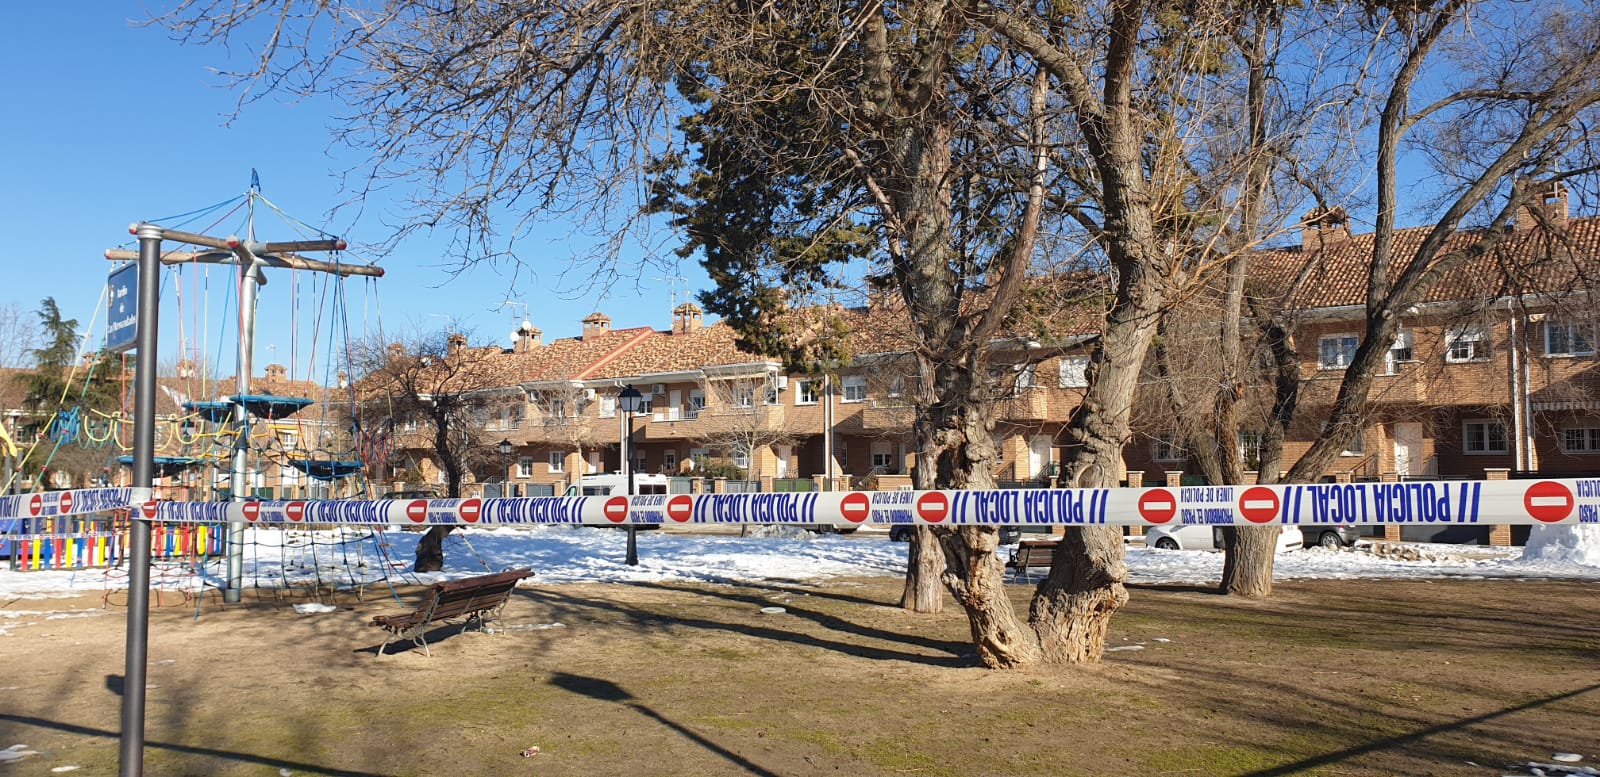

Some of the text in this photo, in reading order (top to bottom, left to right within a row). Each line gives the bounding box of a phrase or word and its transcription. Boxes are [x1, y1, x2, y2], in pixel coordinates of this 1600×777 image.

[972, 489, 1084, 523] POLICIA LOCAL
[1180, 487, 1233, 503] LINEA DE POLICIA
[1307, 482, 1450, 523] POLICIA LOCAL
[318, 500, 380, 522] POLICIA LOCAL
[497, 497, 572, 523] POLICIA LOCAL
[712, 493, 799, 522] POLICIA LOCAL
[1181, 508, 1196, 524] PASO
[1579, 504, 1598, 523] PASO
